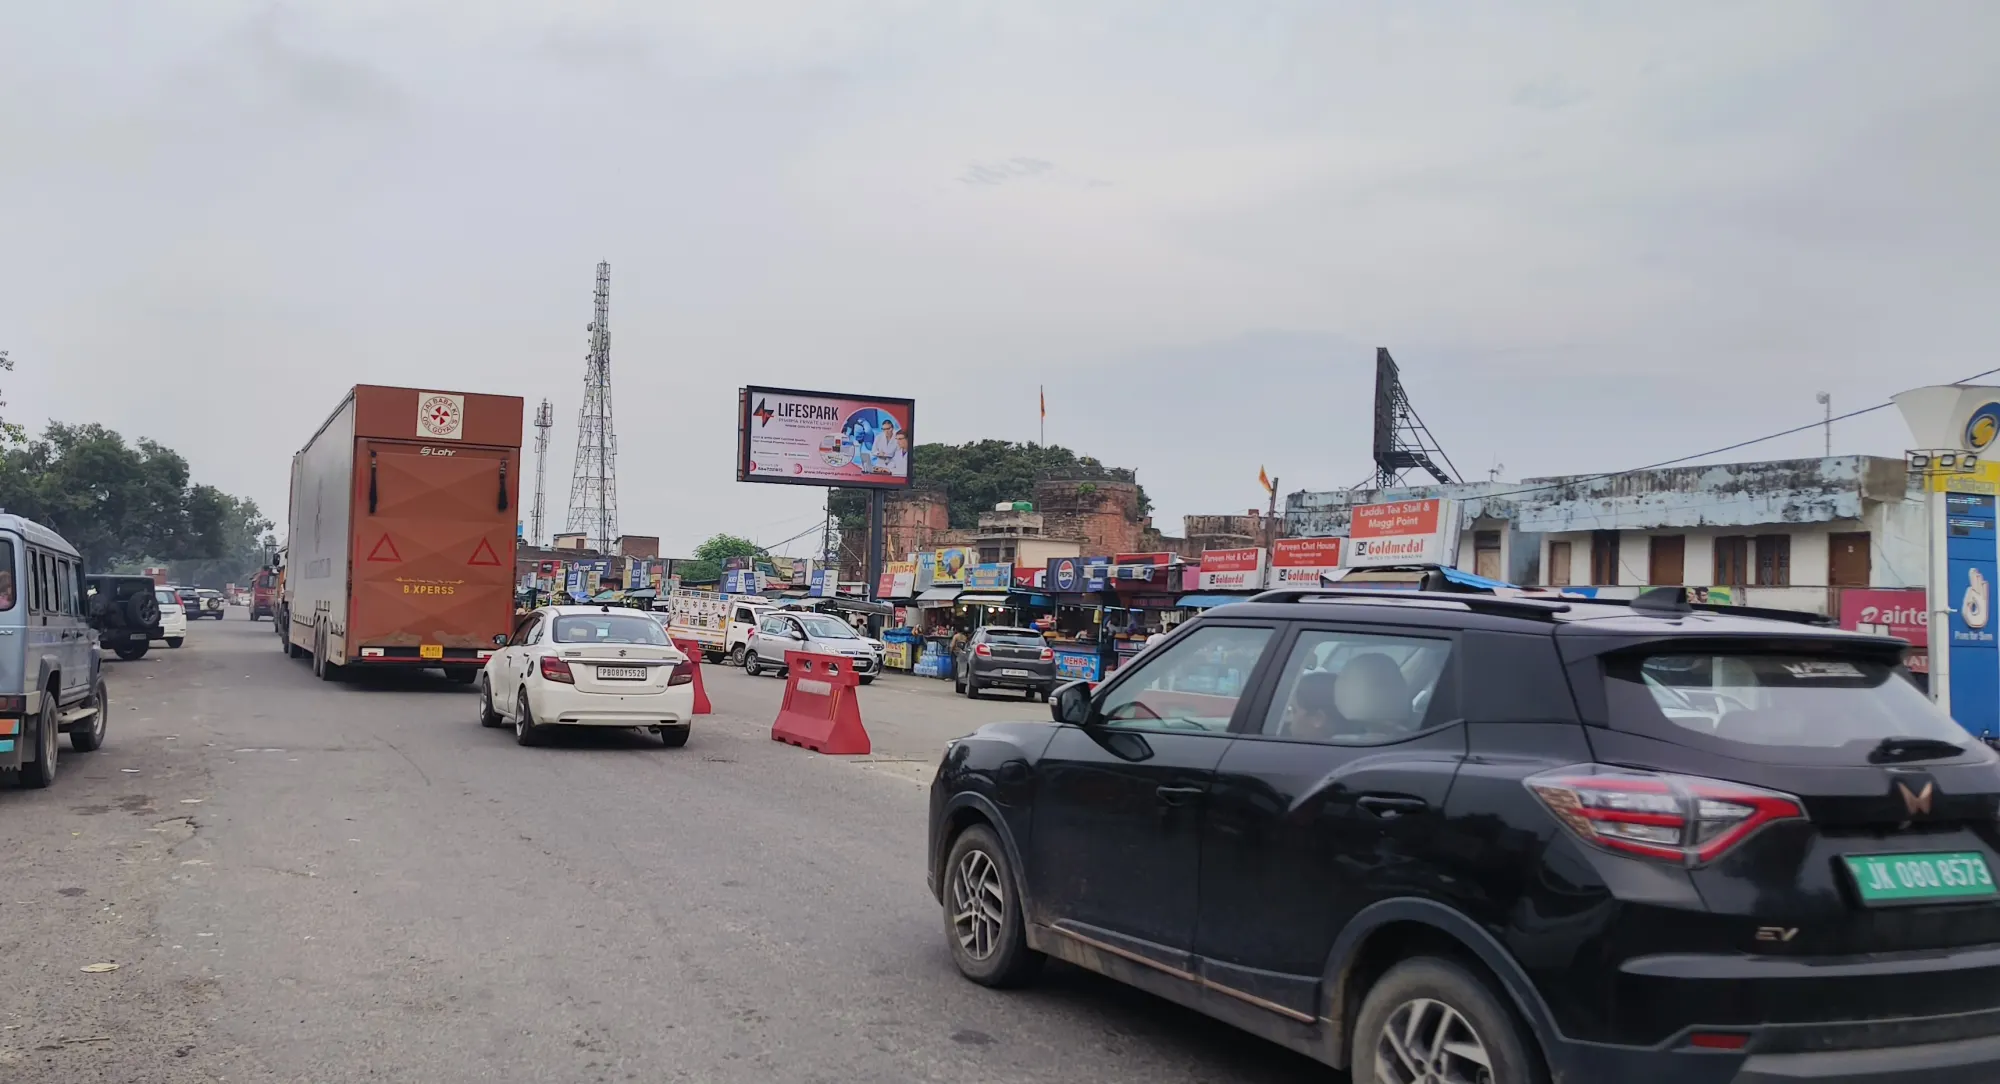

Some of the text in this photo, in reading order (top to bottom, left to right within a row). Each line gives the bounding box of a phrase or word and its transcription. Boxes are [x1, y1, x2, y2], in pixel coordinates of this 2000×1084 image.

[778, 402, 839, 421] LIFESPARK
[431, 447, 457, 456] Lohr
[1360, 501, 1431, 517] Laddu Tea Stall &
[1368, 515, 1419, 530] Maggi Point
[1368, 538, 1425, 555] Goldmedal
[1215, 573, 1245, 584] Goldmedal
[1882, 605, 1929, 626] airte
[1063, 655, 1089, 666] MEHRA
[1867, 861, 1897, 890] JK
[1936, 858, 1993, 887] 8573
[1755, 926, 1799, 941] EV
